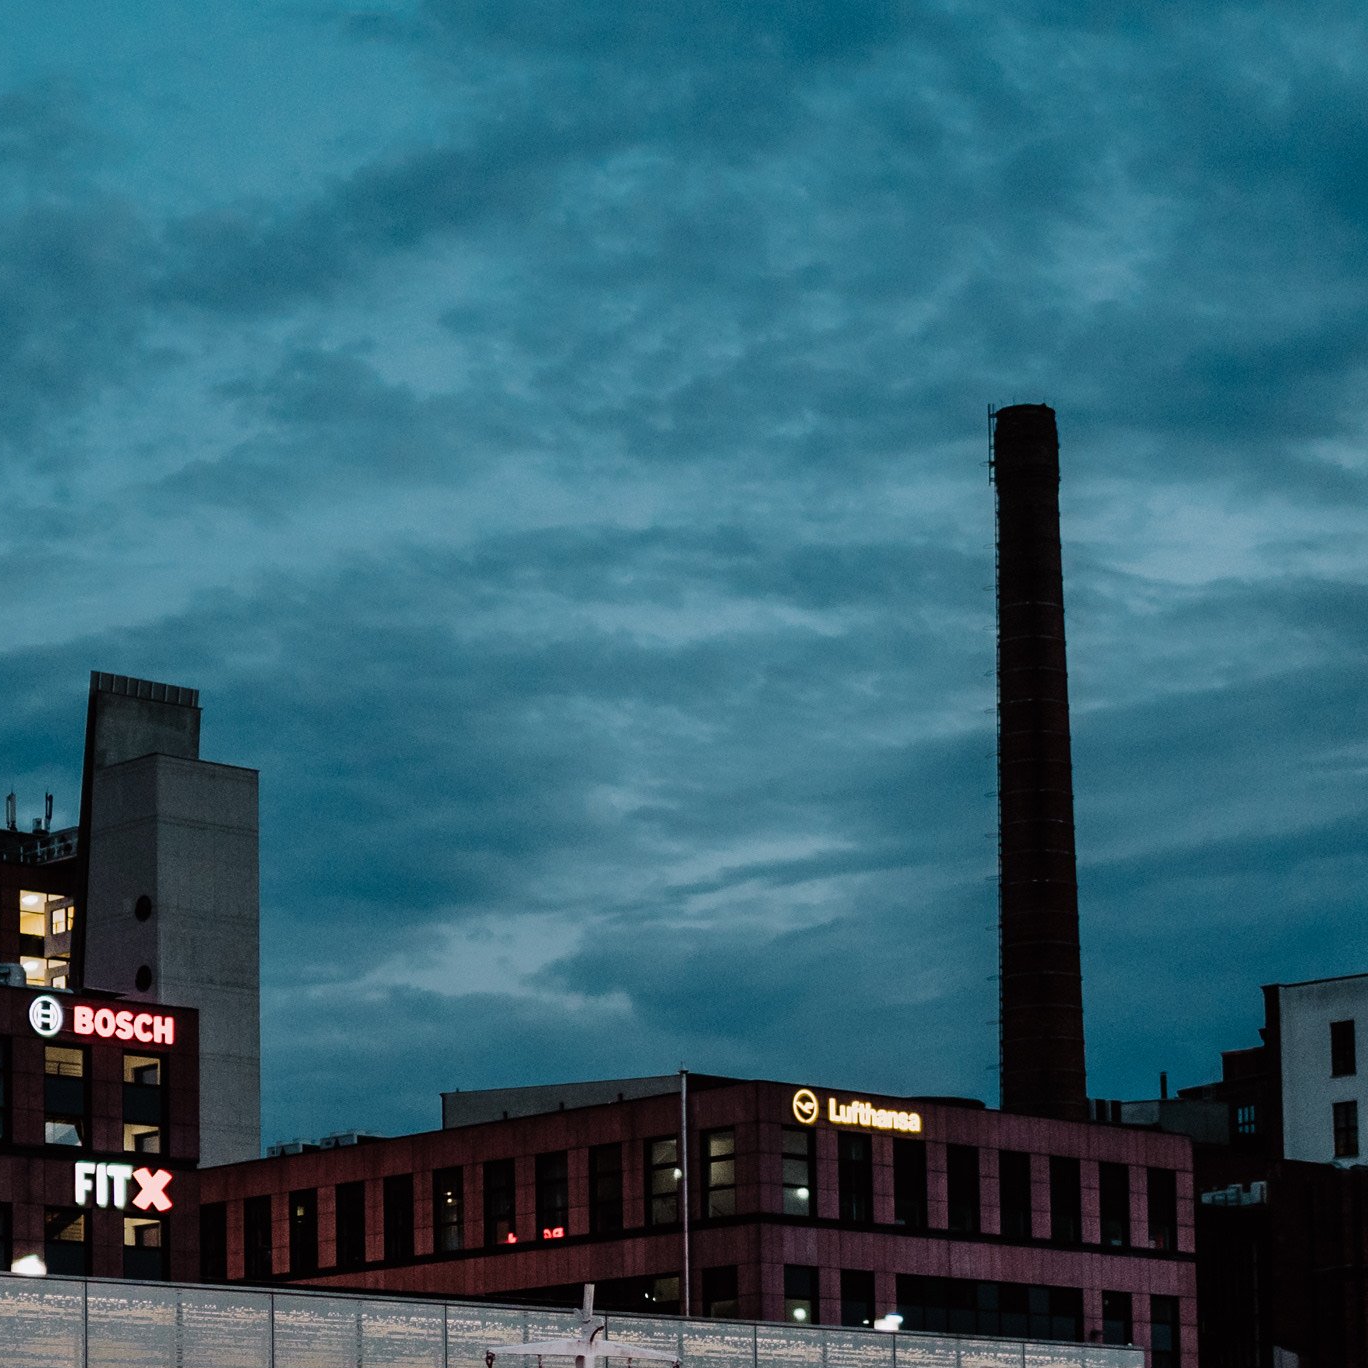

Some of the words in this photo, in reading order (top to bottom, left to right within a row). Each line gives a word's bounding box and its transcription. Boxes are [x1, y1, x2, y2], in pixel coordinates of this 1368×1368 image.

[74, 1006, 175, 1045] BOSCH
[828, 1097, 922, 1132] Lufthansa
[75, 1161, 174, 1212] FITX
